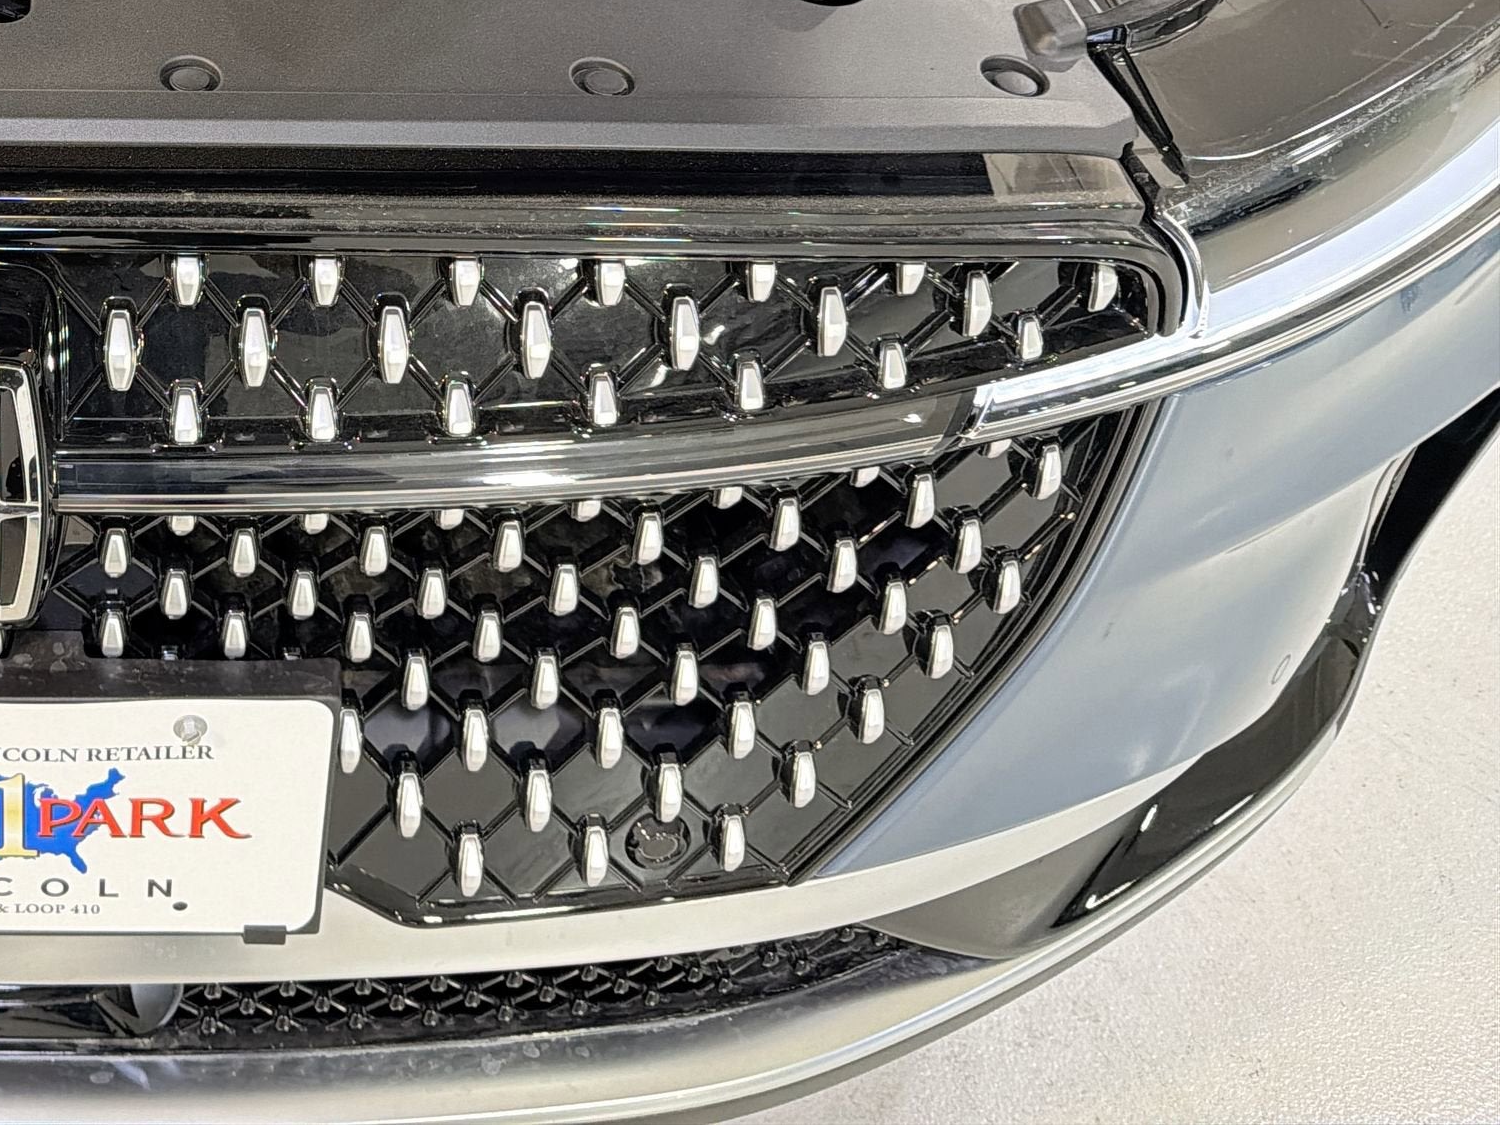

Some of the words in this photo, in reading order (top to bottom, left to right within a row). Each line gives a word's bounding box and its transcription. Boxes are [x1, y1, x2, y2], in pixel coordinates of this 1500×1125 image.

[86, 744, 216, 763] RETAILER
[36, 796, 254, 840] PARK
[15, 903, 67, 915] LOOP
[70, 903, 101, 916] 410
